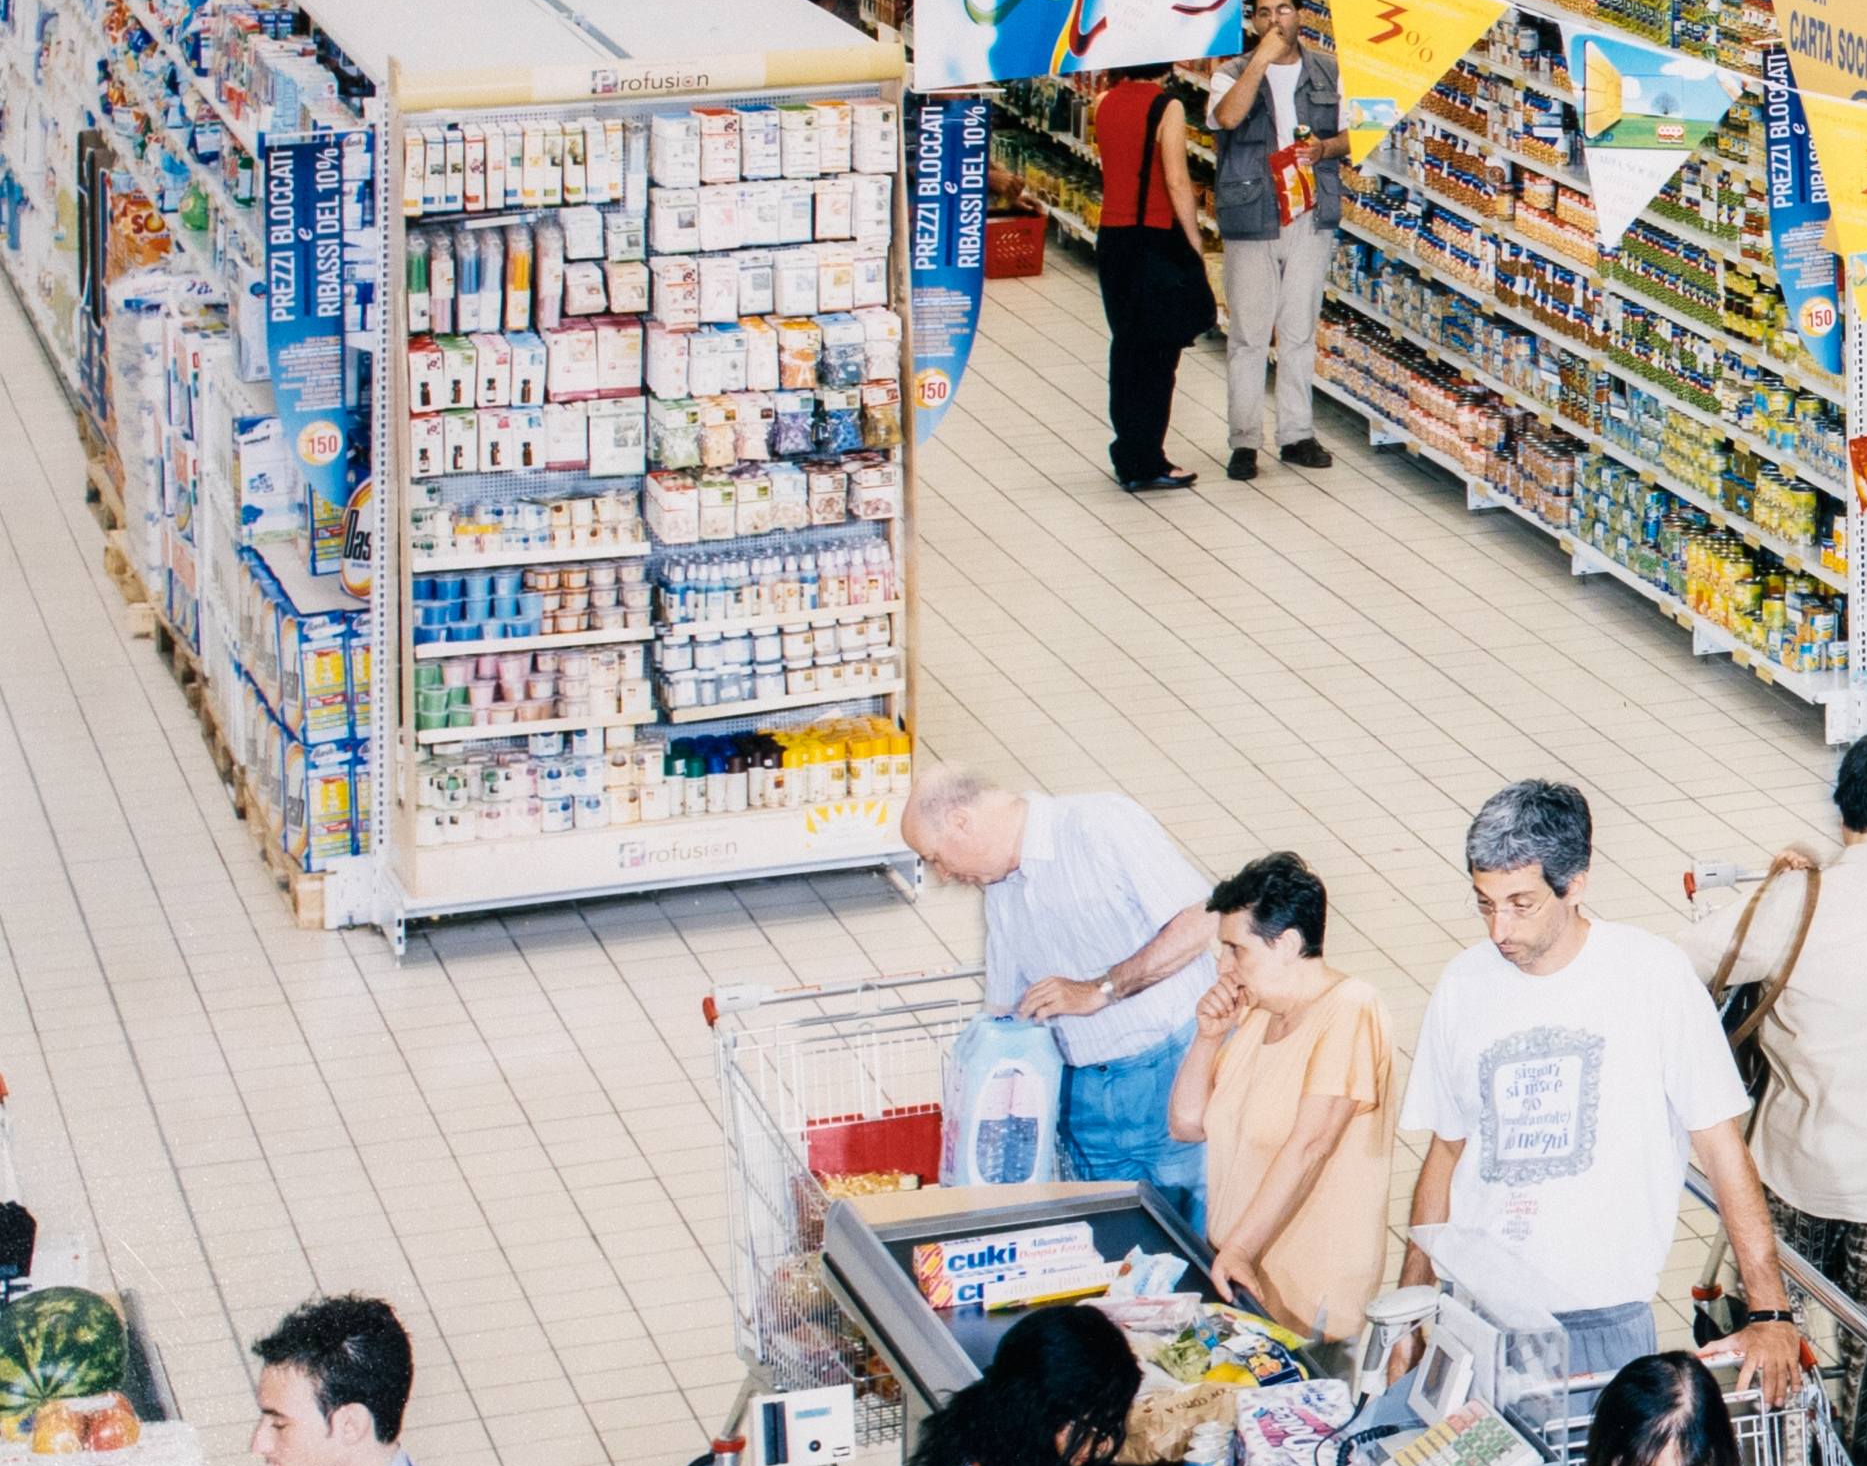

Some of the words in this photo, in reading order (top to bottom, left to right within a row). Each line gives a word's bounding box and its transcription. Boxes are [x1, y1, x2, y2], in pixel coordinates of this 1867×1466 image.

[1790, 11, 1833, 66] CARTA
[591, 70, 710, 94] Profusion
[1769, 53, 1789, 139] BLOCCATI
[964, 105, 986, 148] 10%
[314, 147, 341, 193] 10%
[918, 106, 944, 196] BLOCCATI
[961, 152, 984, 188] DEL
[270, 150, 294, 245] BLOCCATI
[944, 182, 957, 194] e
[1773, 144, 1793, 209] PREZZI
[317, 194, 340, 235] DEL
[958, 194, 982, 268] RIBASSI
[915, 203, 940, 270] PREZZI
[270, 249, 295, 322] PREZZI
[316, 237, 341, 317] RIBASSI
[1808, 309, 1833, 327] 150
[919, 381, 947, 400] 150
[309, 434, 338, 453] 150
[619, 837, 738, 869] Profusion
[1514, 1058, 1562, 1081] signori
[947, 1243, 1017, 1272] cuki
